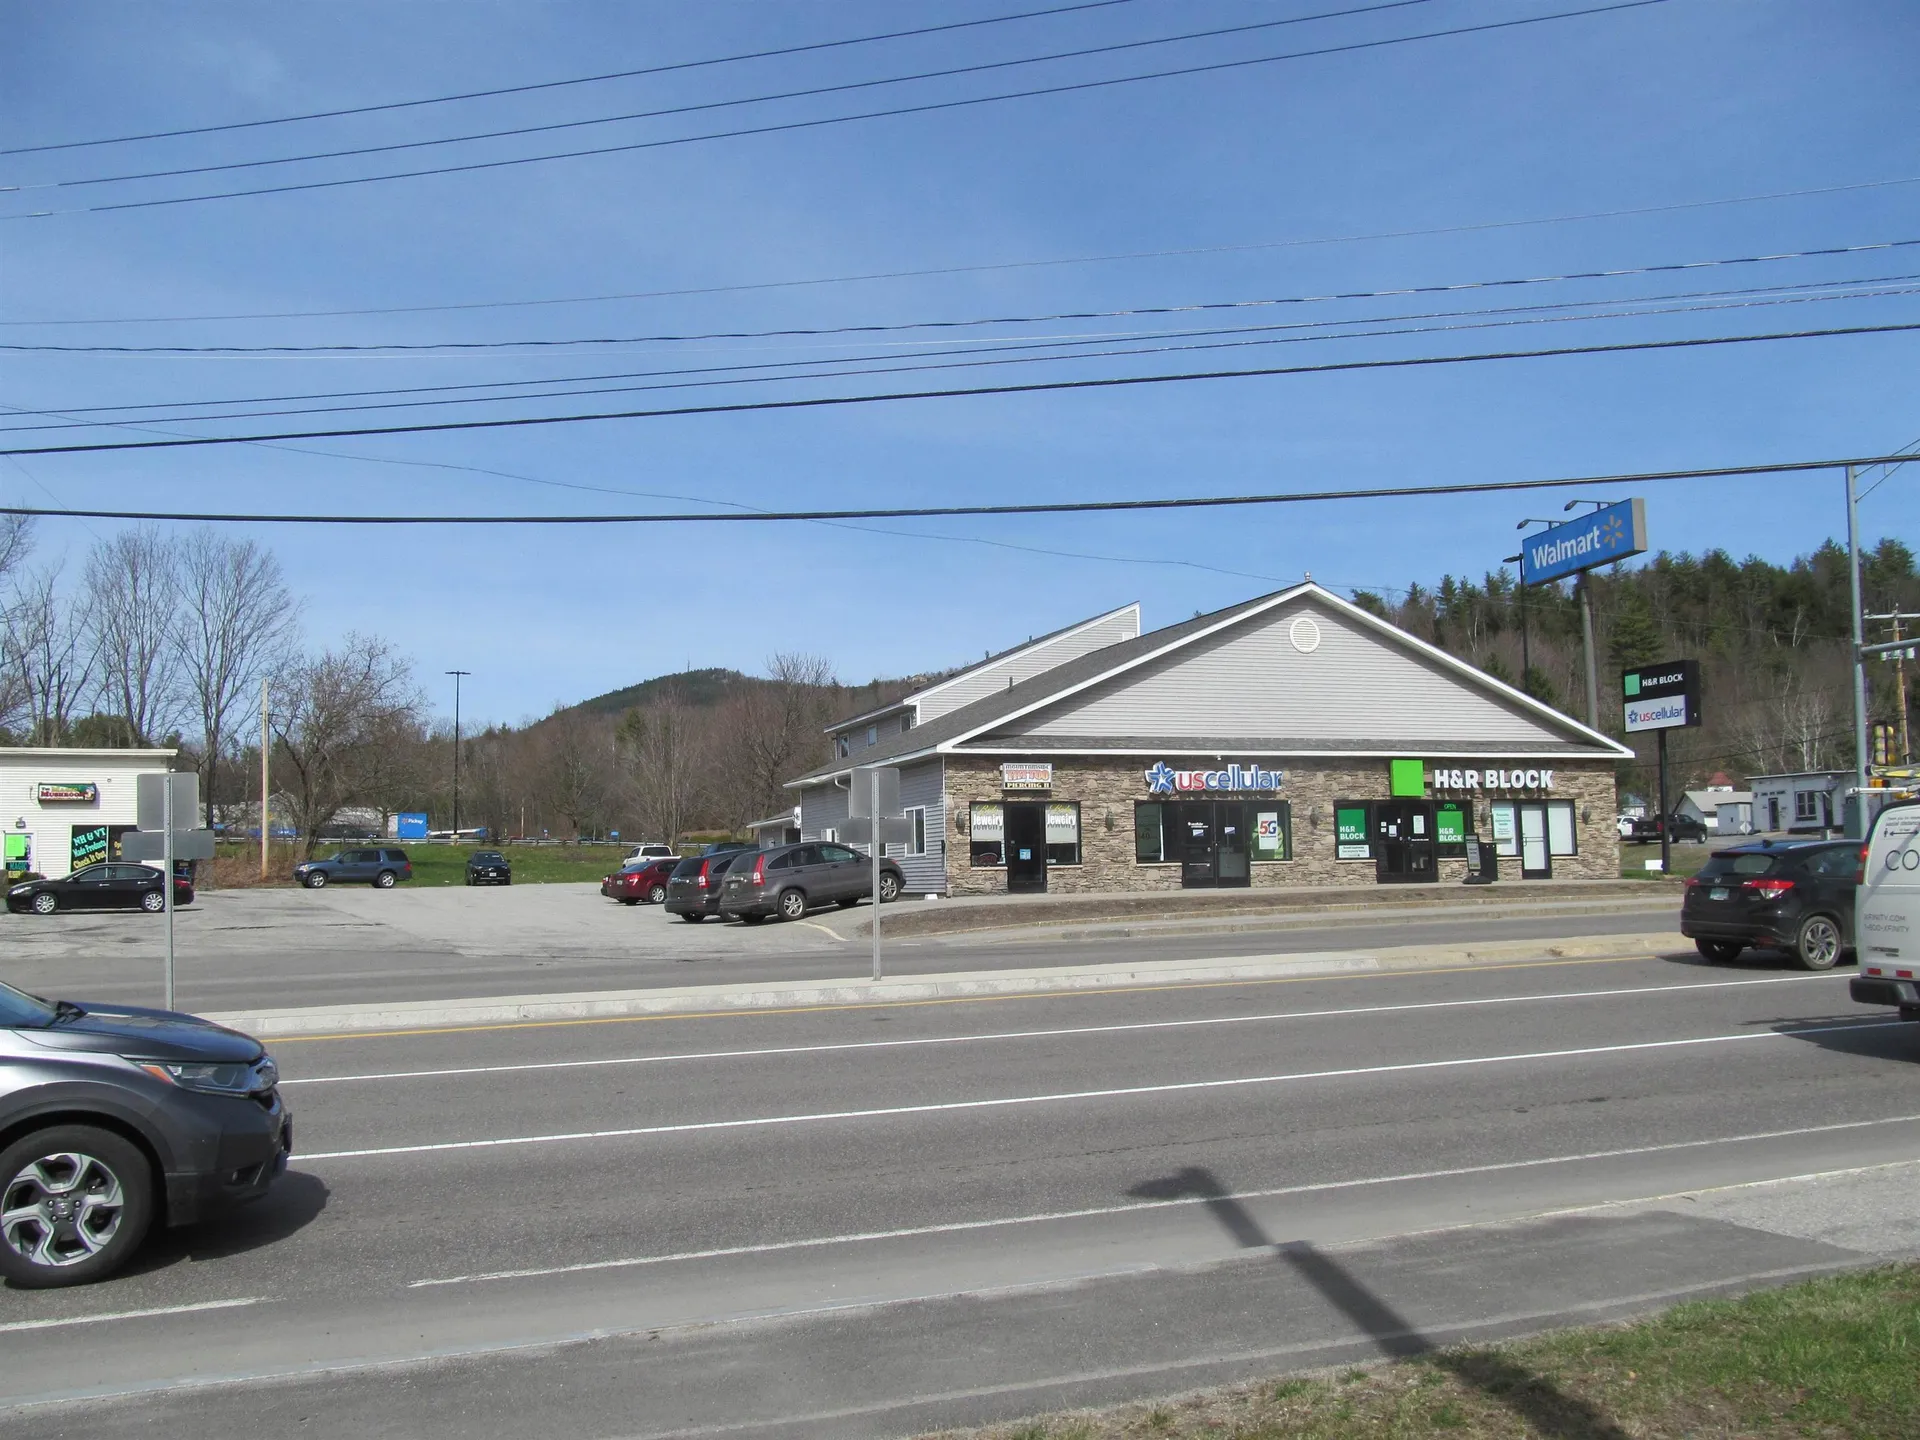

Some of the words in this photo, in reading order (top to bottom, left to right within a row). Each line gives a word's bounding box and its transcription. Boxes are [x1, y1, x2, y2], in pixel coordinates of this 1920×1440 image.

[1532, 525, 1600, 569] Walmart
[1642, 678, 1658, 687] H&R
[1659, 673, 1683, 683] BLOCK
[1640, 706, 1684, 722] uscellular
[1006, 770, 1049, 780] TATTOO
[1176, 764, 1282, 791] uscellular
[1434, 769, 1479, 788] H&R
[1485, 769, 1553, 788] BLOCK
[1260, 820, 1277, 834] 5G
[73, 835, 87, 846] NH
[94, 827, 105, 838] VT
[73, 857, 91, 869] Check
